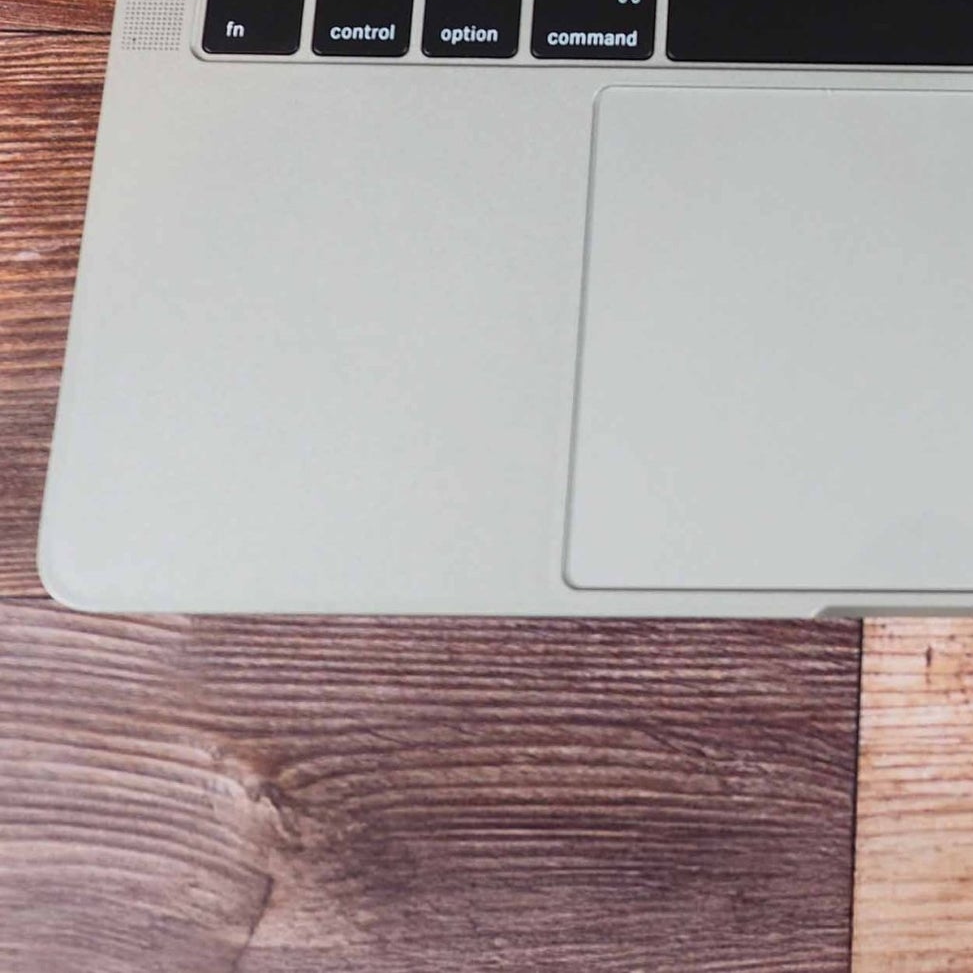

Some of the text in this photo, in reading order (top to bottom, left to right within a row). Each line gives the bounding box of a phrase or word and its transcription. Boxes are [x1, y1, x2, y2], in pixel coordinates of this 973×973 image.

[227, 21, 244, 37] fn
[330, 25, 396, 40] control
[441, 26, 498, 44] option
[548, 30, 637, 46] command
